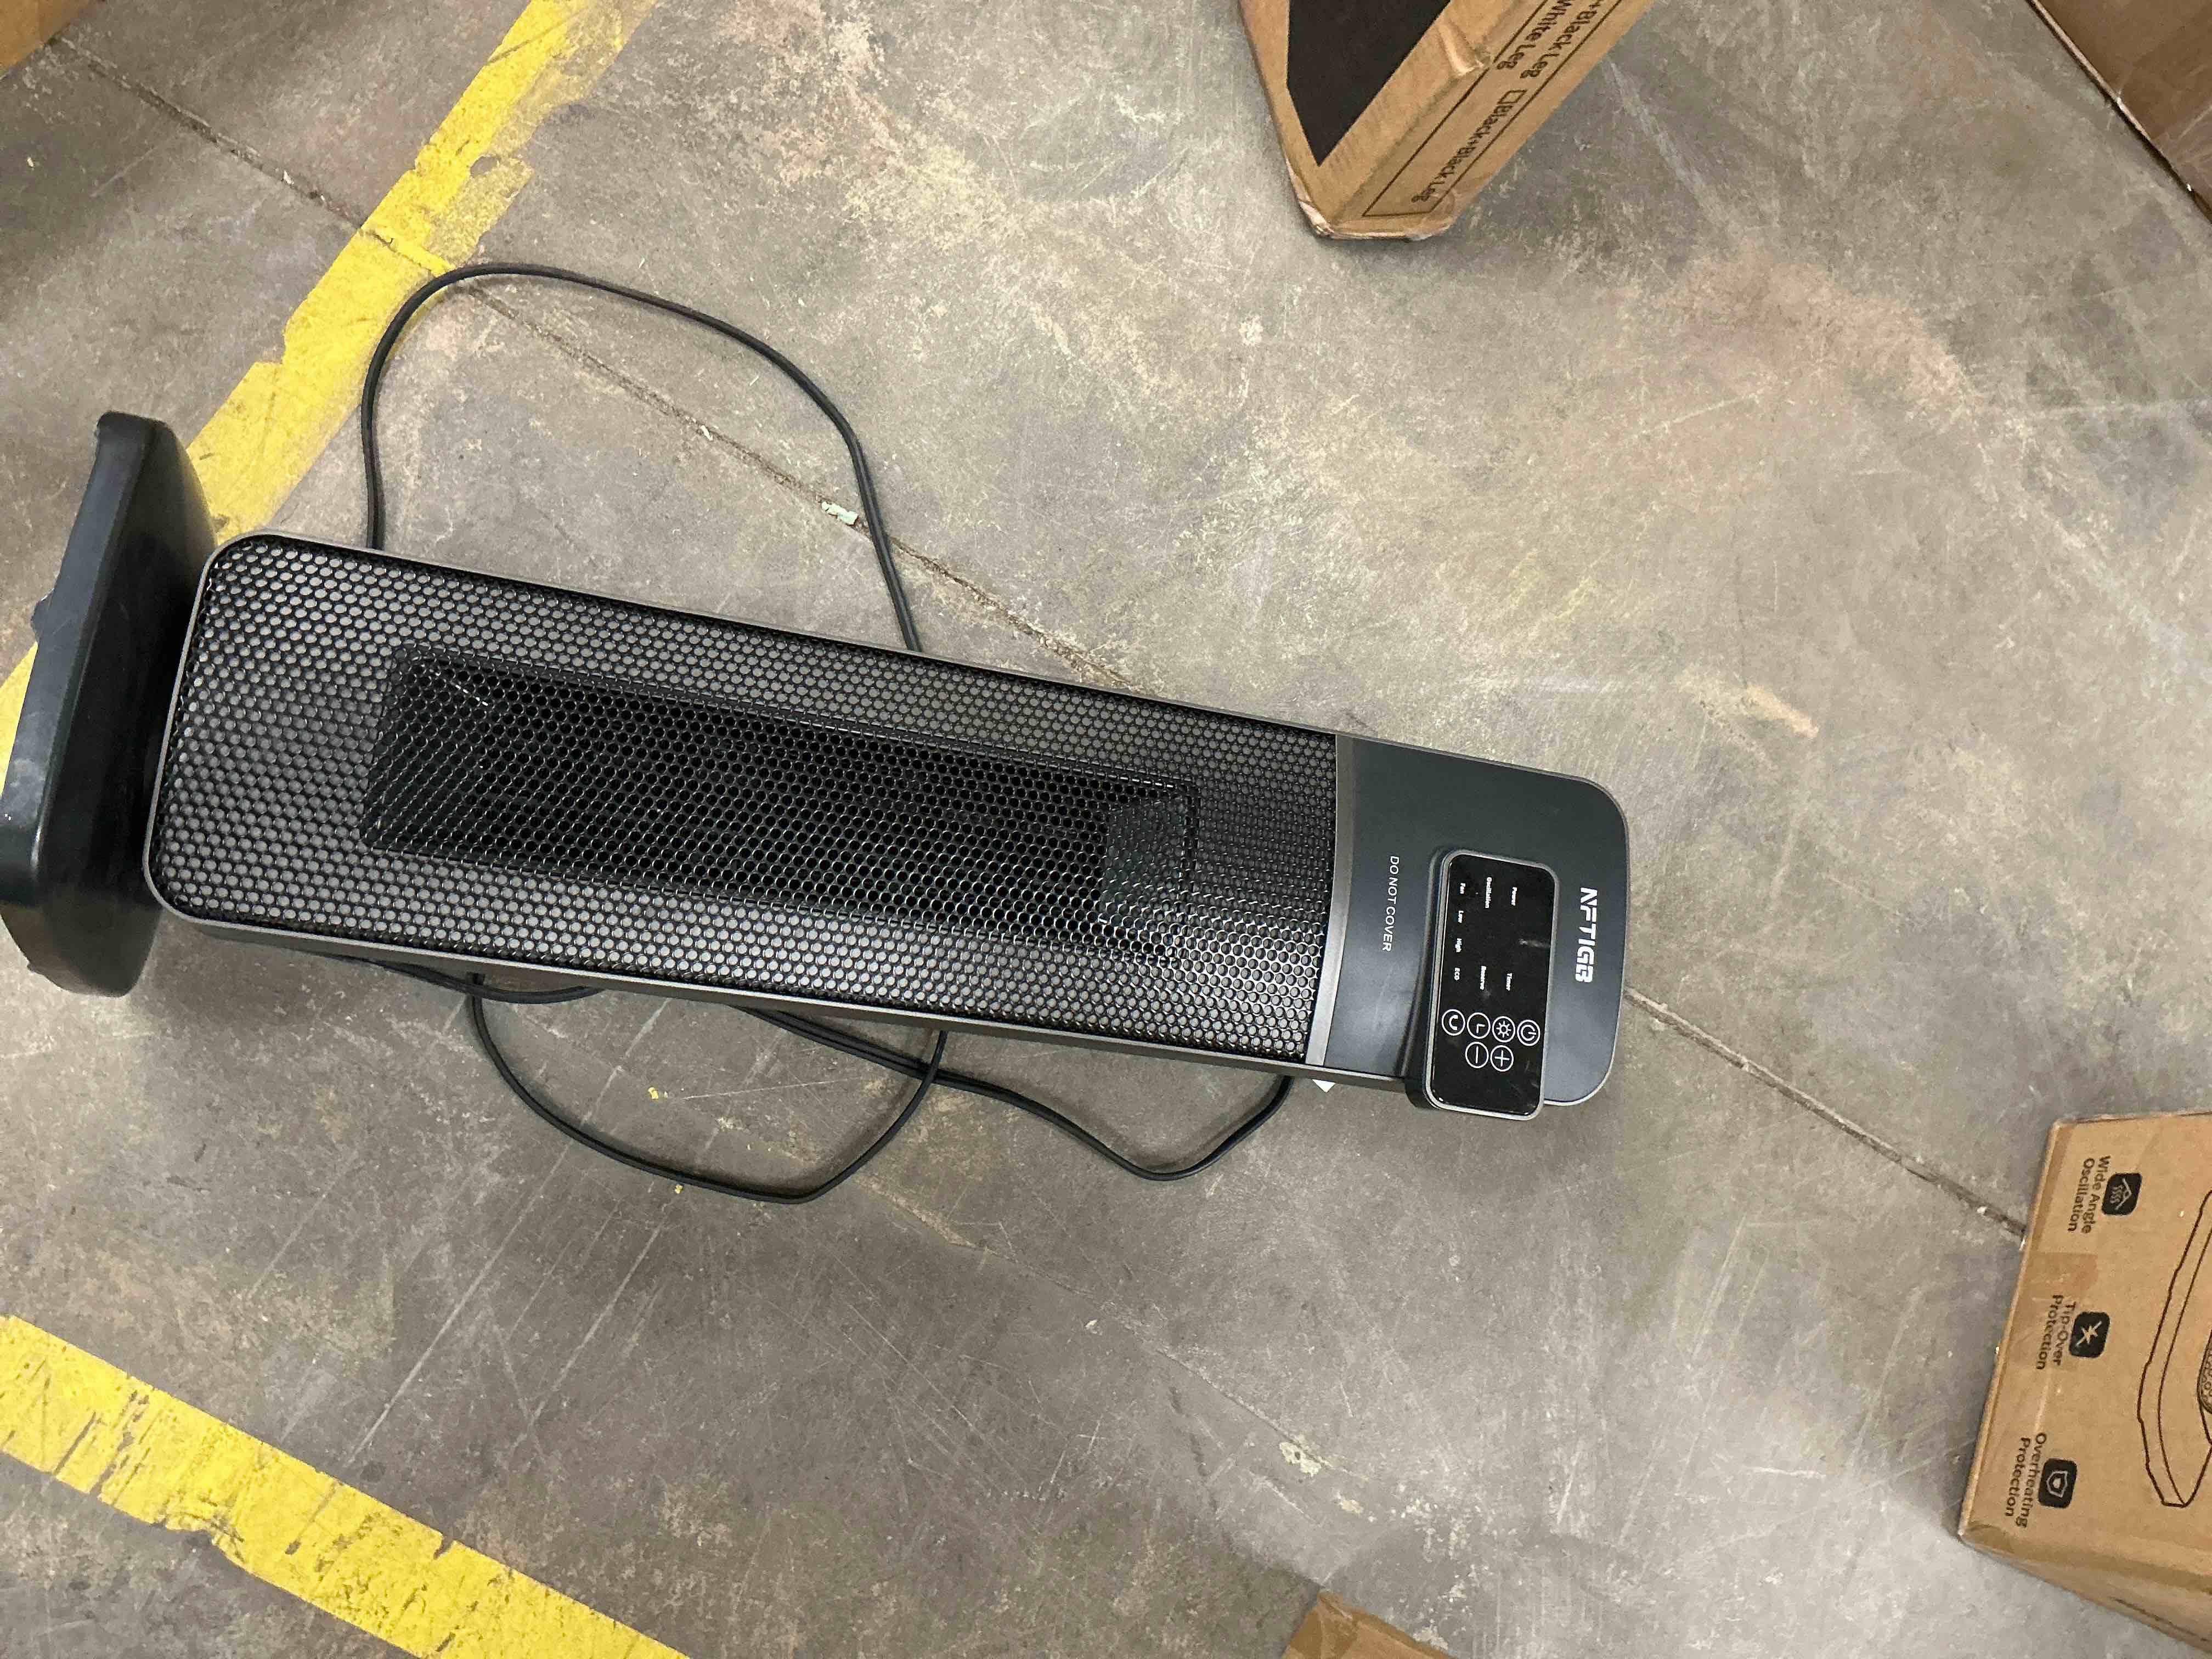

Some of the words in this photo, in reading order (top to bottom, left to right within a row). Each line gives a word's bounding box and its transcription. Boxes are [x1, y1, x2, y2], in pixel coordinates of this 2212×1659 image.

[1525, 0, 1574, 40] White
[1497, 44, 1536, 70] Leg
[1519, 53, 1560, 78] Leg
[1411, 182, 1446, 202] Leg
[1390, 856, 1400, 875] DO
[1387, 877, 1398, 905] NOT
[1382, 906, 1396, 952] COVER
[2092, 1155, 2111, 1190] Wide
[2067, 1158, 2095, 1232] Oscillation
[2081, 1193, 2100, 1233] Angle
[2036, 1295, 2064, 1370] Protection
[2053, 1301, 2076, 1365] Tip-Over
[2005, 1437, 2031, 1516] Protection
[2015, 1432, 2047, 1528] Overheating
